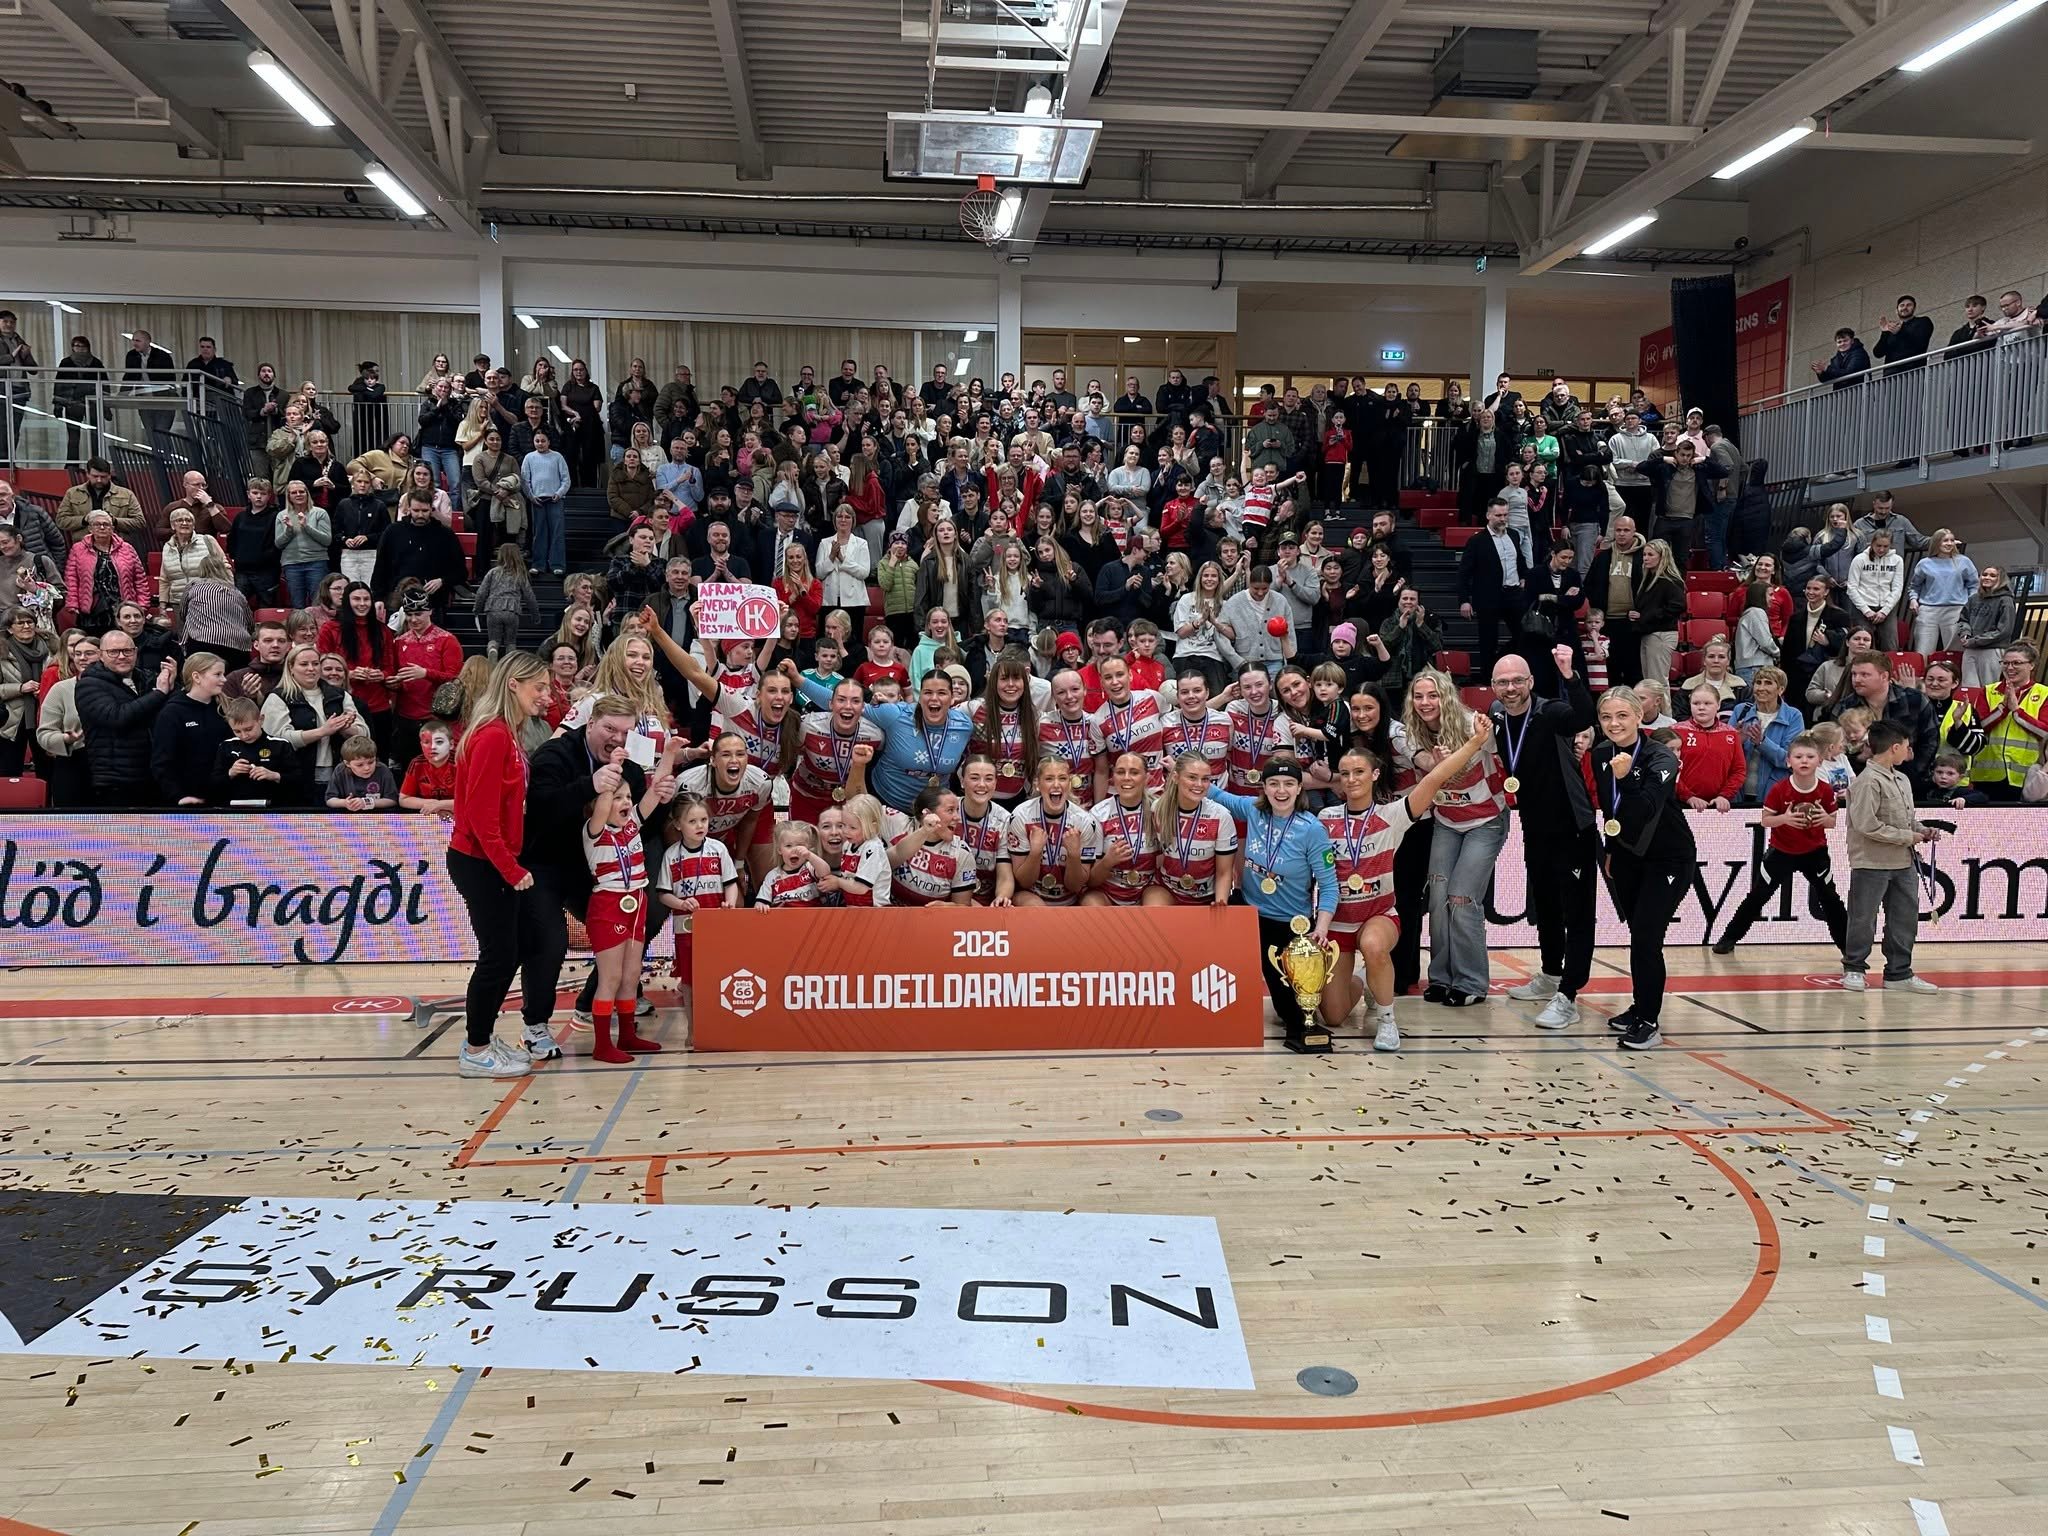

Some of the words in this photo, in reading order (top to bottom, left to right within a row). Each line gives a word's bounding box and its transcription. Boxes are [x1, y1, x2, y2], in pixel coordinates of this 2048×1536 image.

[700, 613, 718, 622] ERU
[744, 604, 769, 630] HK
[1687, 738, 1697, 746] 22
[717, 799, 736, 815] 22
[1197, 826, 1207, 834] HK
[910, 849, 931, 871] 88
[909, 875, 941, 893] Arion
[136, 854, 166, 928] í
[193, 837, 430, 963] bragði
[953, 931, 1010, 957] 2026
[735, 987, 752, 996] 66
[784, 971, 1176, 1011] GRILLDEILDARMEISTARAR
[142, 1263, 1219, 1330] SYRUSSON
